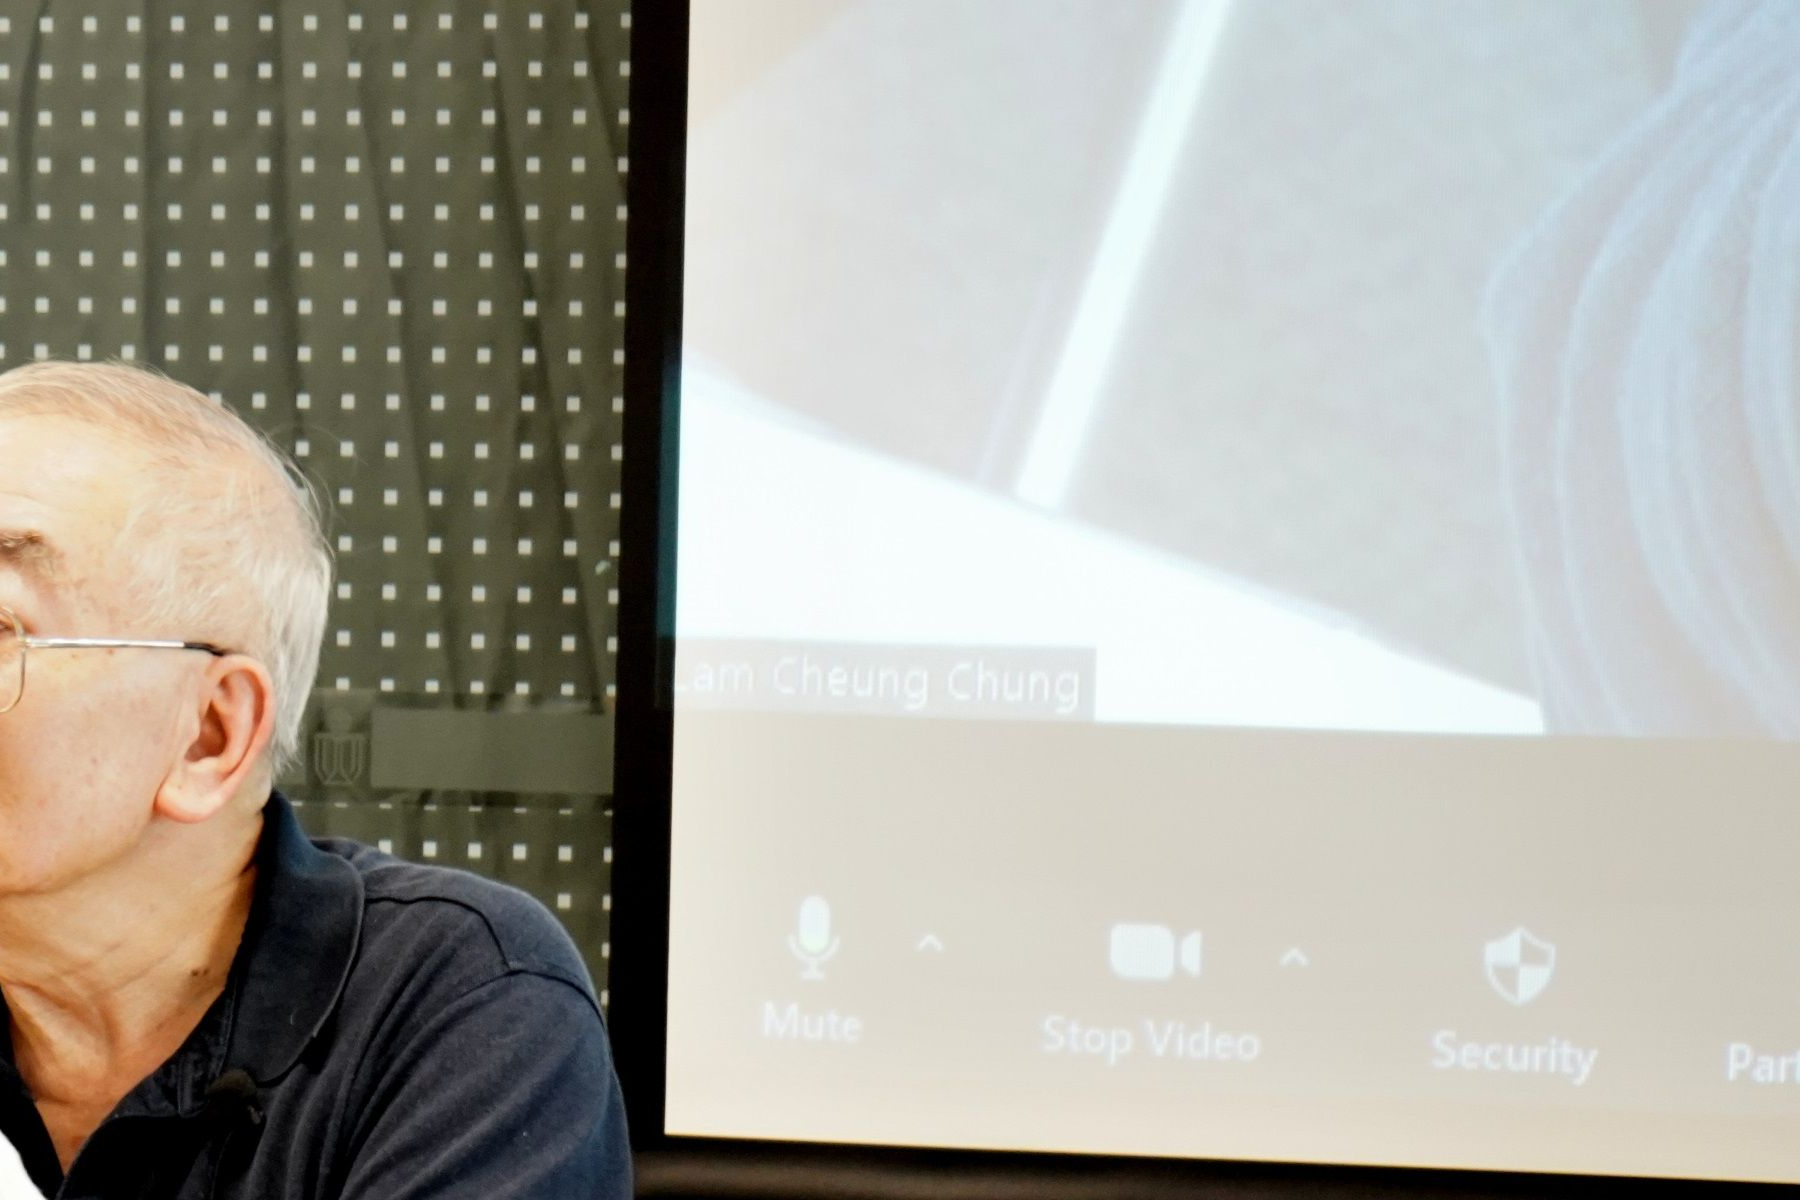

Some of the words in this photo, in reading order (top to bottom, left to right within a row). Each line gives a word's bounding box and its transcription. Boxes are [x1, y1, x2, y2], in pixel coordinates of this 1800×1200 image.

[773, 654, 930, 711] Cheung
[946, 660, 1081, 714] Chung
[761, 1001, 863, 1044] Mute
[1042, 1014, 1134, 1067] Stop
[1149, 1019, 1261, 1062] Video
[1431, 1030, 1598, 1088] Security
